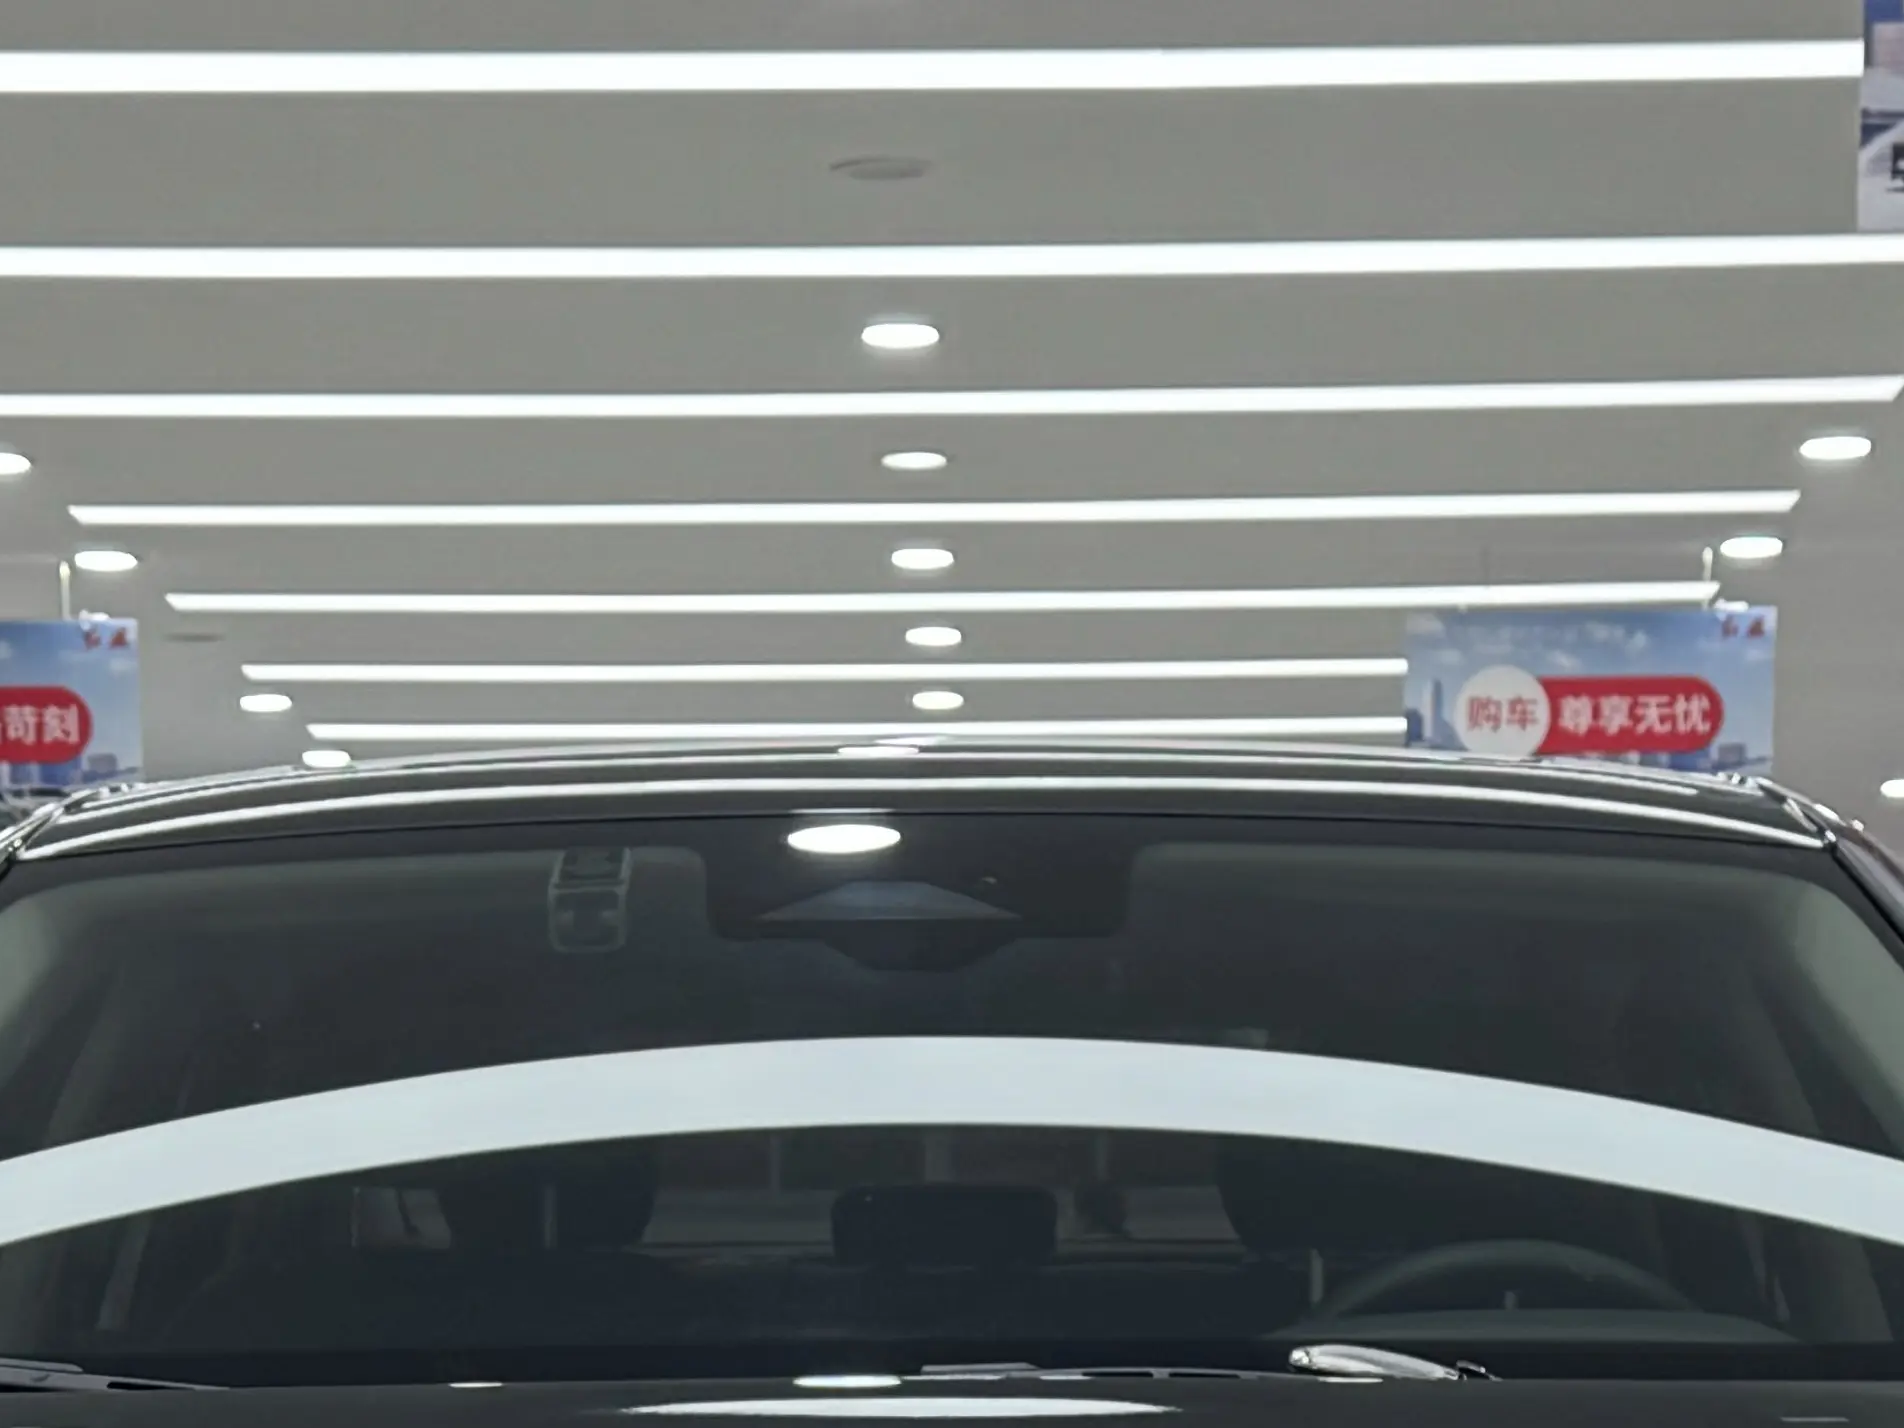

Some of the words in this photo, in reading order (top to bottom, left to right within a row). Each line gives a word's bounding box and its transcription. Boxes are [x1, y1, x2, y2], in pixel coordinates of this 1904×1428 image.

[1466, 696, 1538, 731] 购车
[1558, 693, 1711, 735] 尊享无忧
